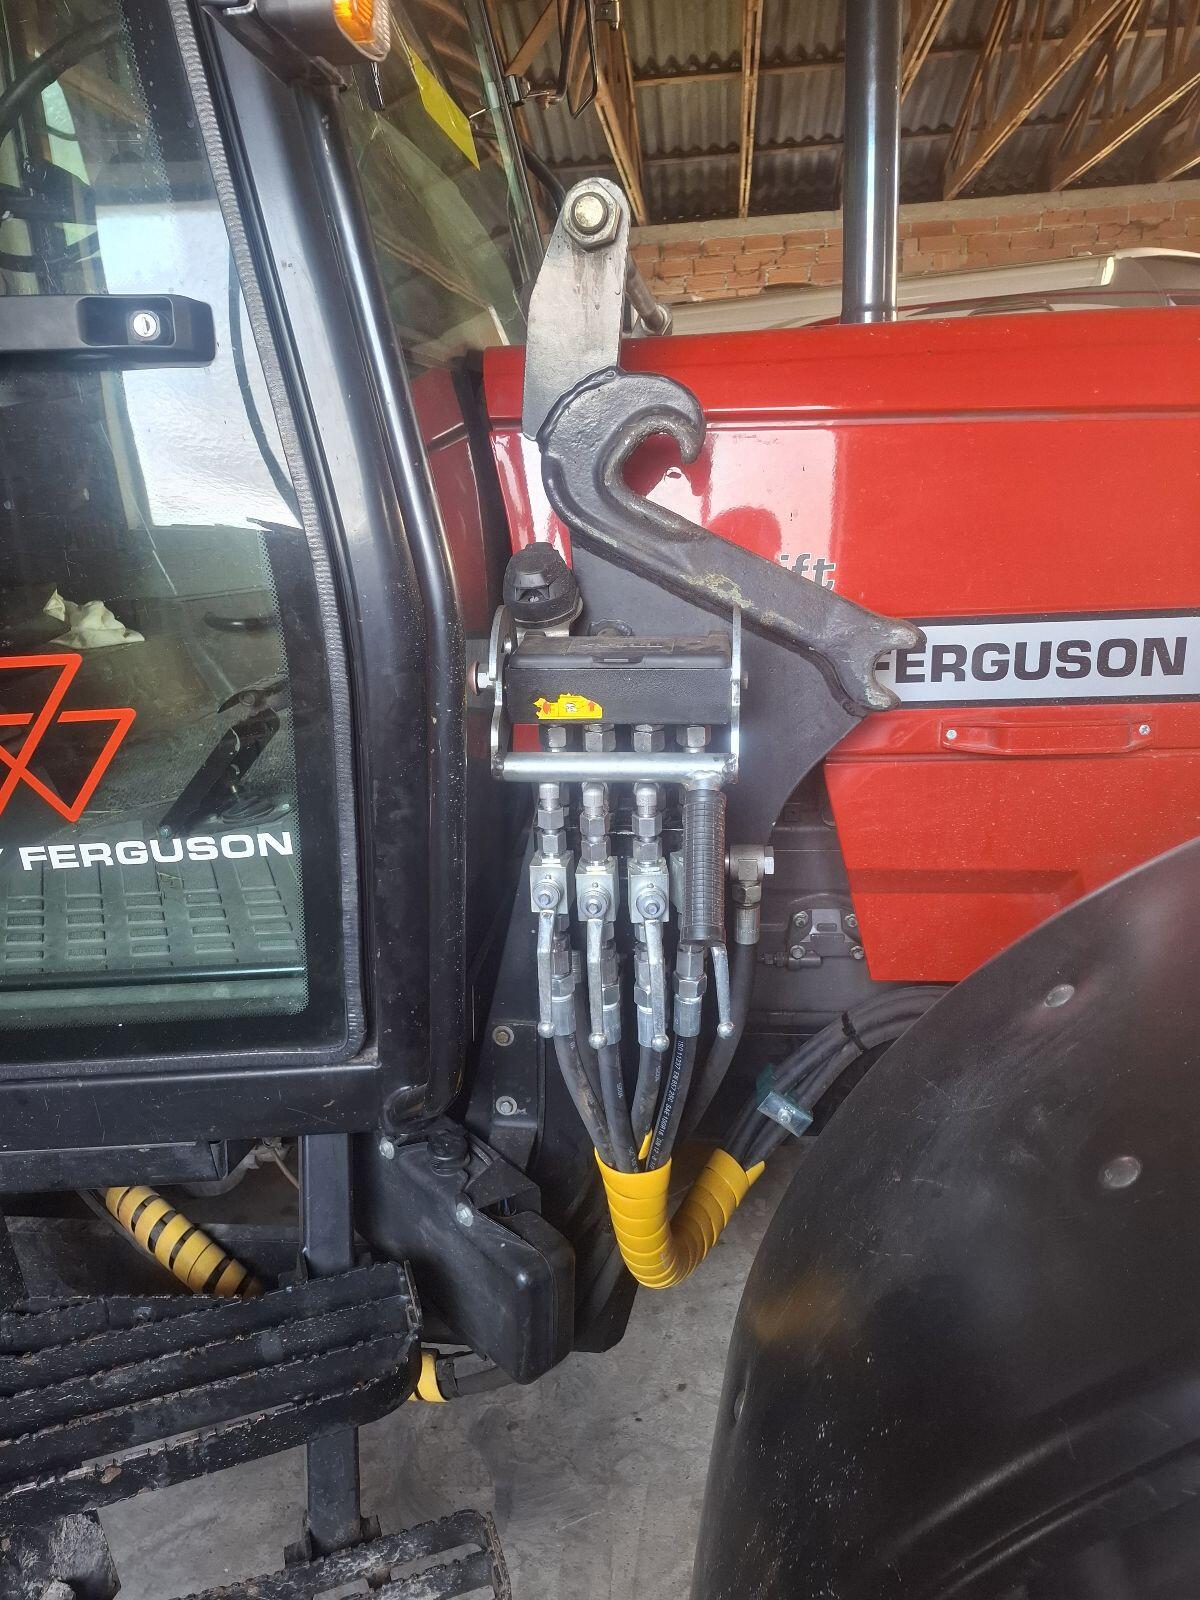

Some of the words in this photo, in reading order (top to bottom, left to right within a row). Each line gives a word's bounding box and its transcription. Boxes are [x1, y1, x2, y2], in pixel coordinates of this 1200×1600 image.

[18, 831, 294, 871] FERGUSON
[677, 1040, 685, 1052] ISO
[663, 1103, 672, 1116] SAE
